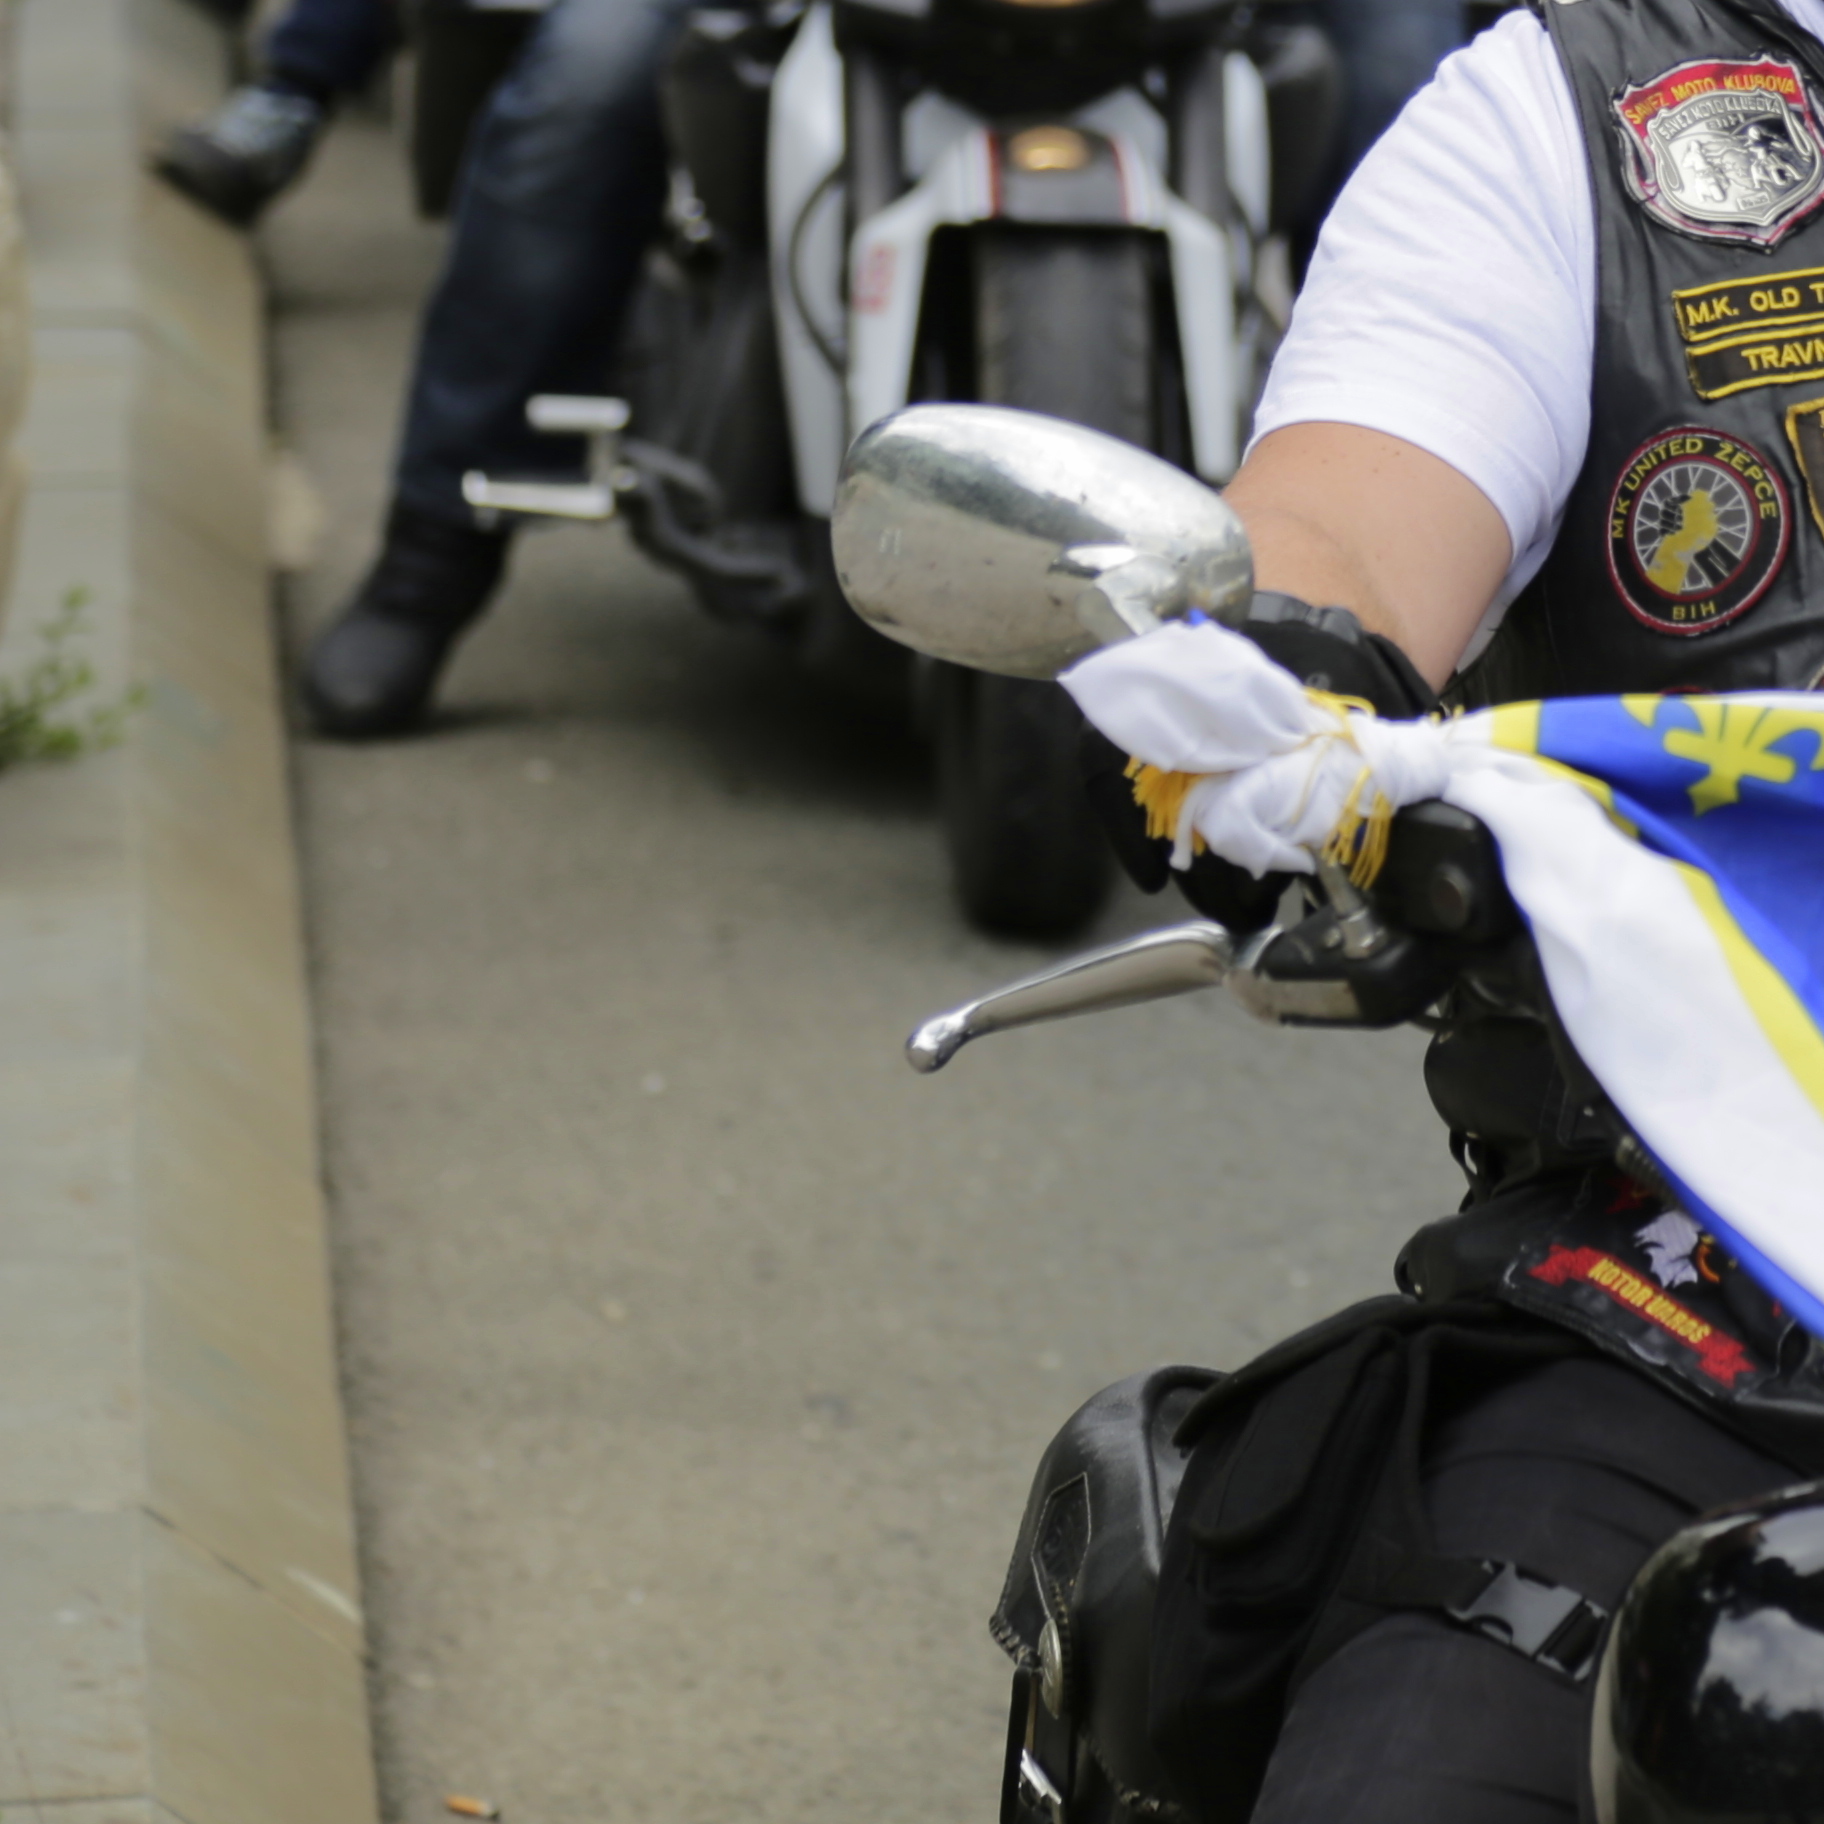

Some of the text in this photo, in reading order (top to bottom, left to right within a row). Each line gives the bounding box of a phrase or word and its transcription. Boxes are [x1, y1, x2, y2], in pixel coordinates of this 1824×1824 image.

[1671, 77, 1717, 102] MOTO
[1723, 74, 1796, 94] KLUBOVA
[1685, 296, 1740, 326] M.K.
[1750, 286, 1800, 312] OLD
[1612, 497, 1632, 539] MK
[1623, 437, 1704, 492] UNITED
[1671, 600, 1717, 621] BIH
